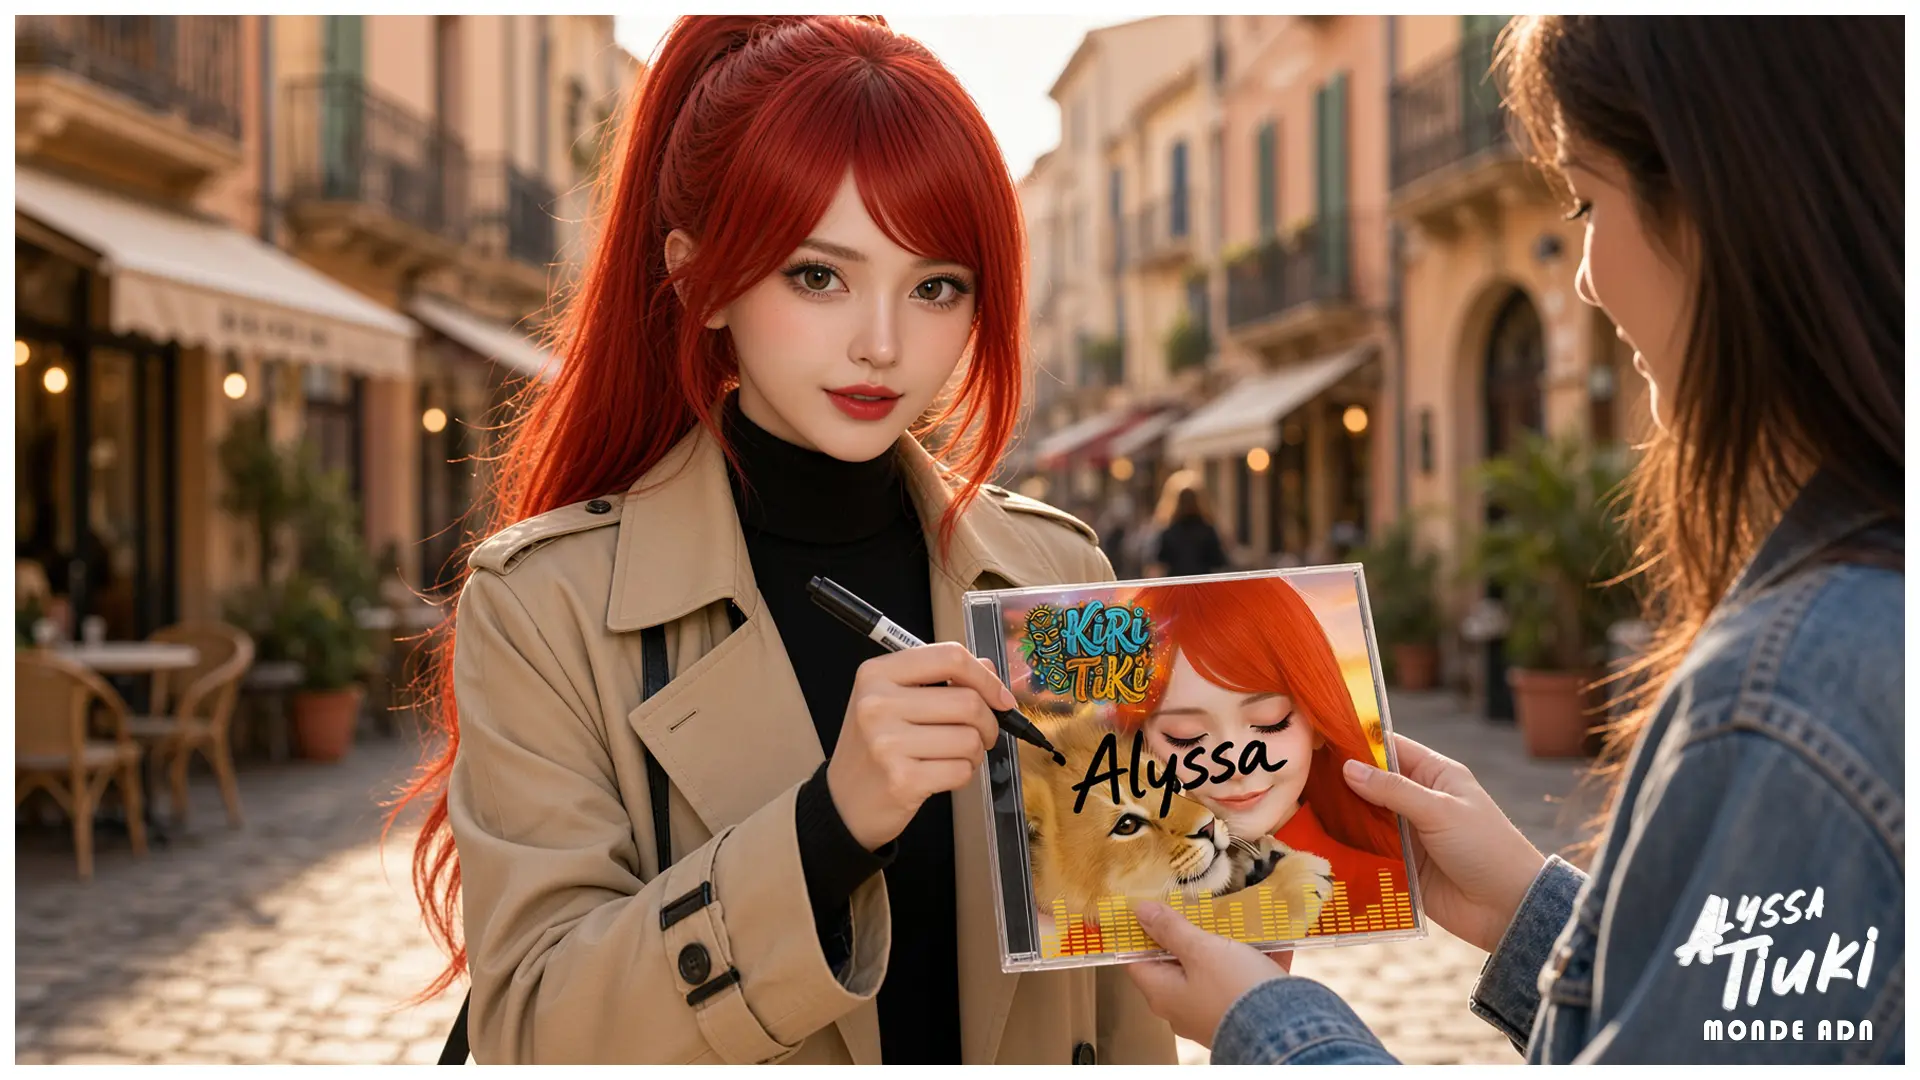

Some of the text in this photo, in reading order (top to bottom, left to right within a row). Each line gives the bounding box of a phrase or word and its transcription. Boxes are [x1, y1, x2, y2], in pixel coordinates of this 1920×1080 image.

[1061, 600, 1149, 656] KiRi
[1065, 655, 1149, 703] TiKi
[1071, 729, 1288, 819] Alyssa
